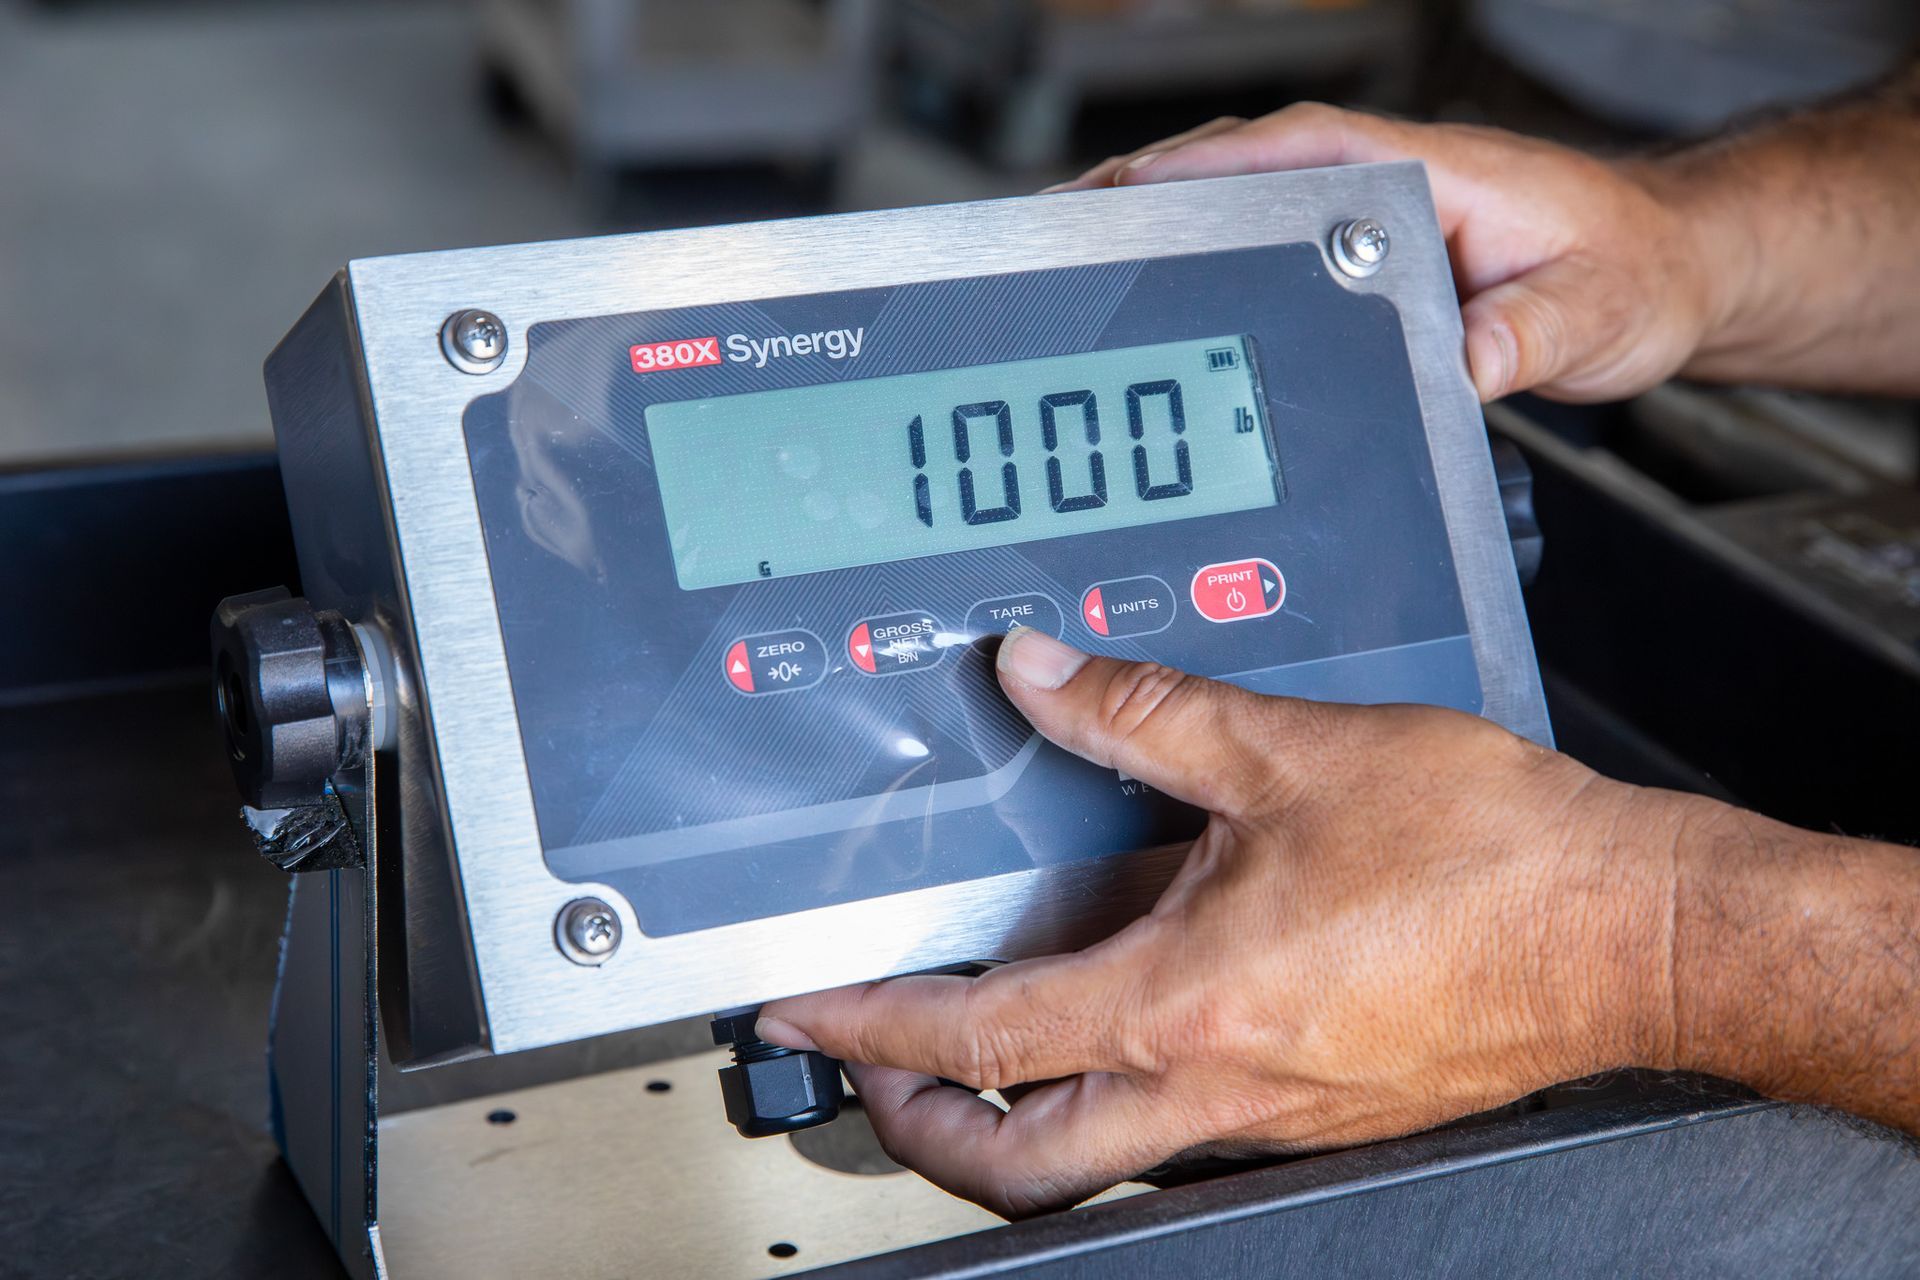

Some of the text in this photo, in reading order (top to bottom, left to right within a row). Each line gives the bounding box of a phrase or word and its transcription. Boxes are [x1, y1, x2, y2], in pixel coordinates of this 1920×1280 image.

[635, 327, 864, 369] 380X Synergy
[1234, 406, 1254, 434] lb
[908, 378, 1193, 528] 1000
[1207, 569, 1254, 586] PRINT
[989, 604, 1034, 620] TARE
[1111, 598, 1159, 615] UNITS
[873, 621, 934, 639] GROSS
[757, 641, 805, 658] ZERO
